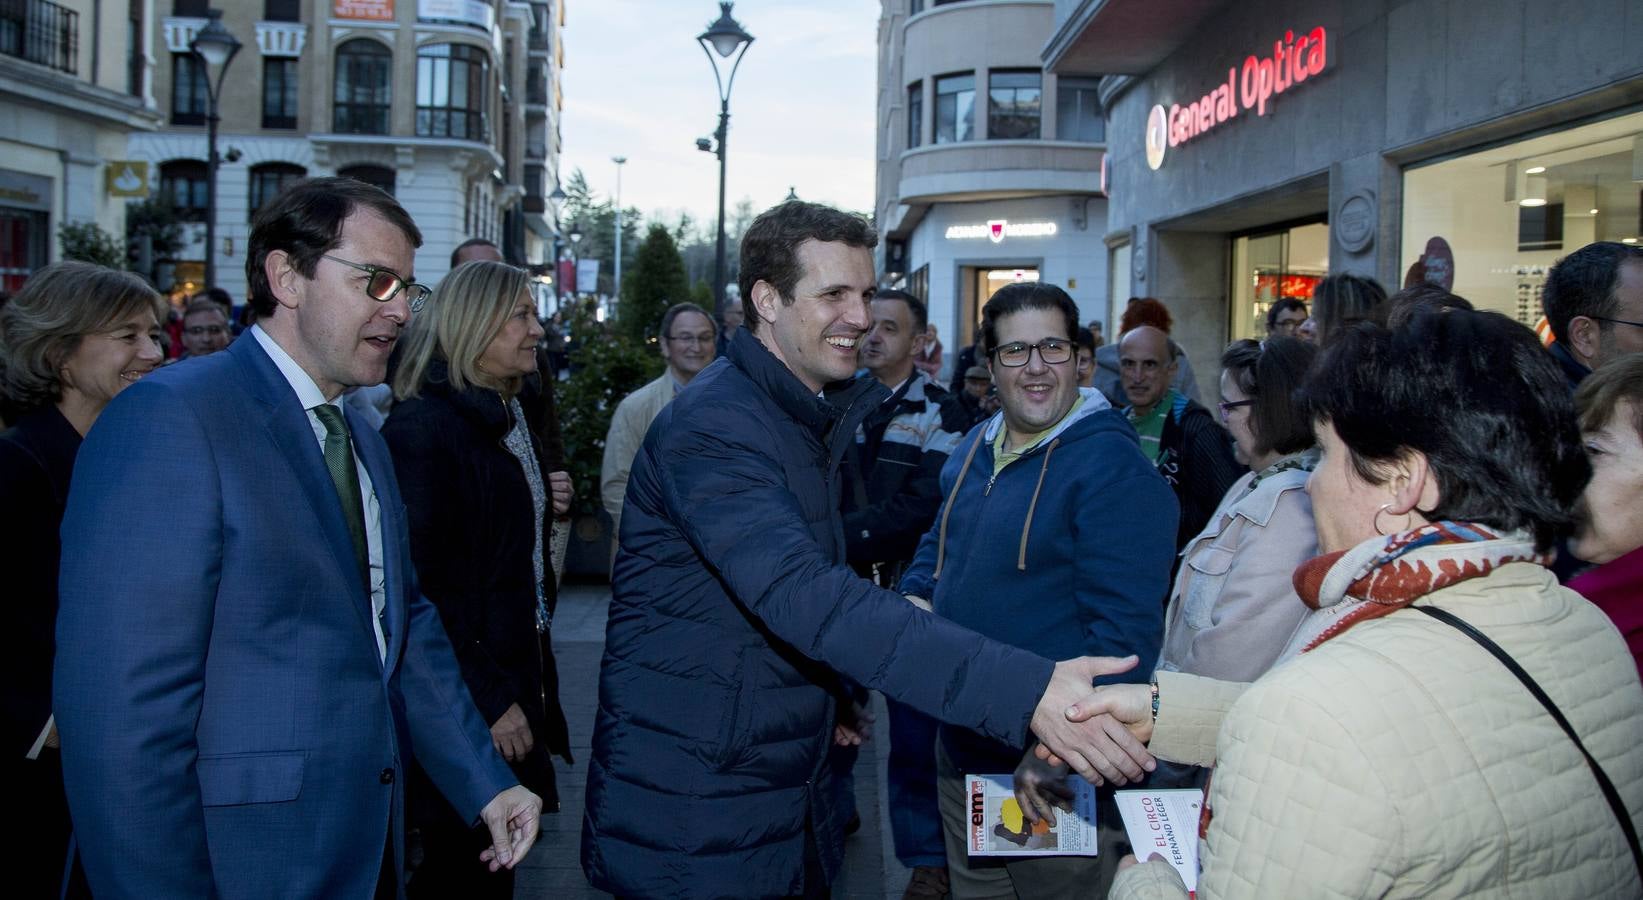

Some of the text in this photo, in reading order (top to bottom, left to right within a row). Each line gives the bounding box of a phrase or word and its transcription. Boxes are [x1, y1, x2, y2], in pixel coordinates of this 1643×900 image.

[1167, 25, 1327, 148] General Optica
[1141, 797, 1167, 847] EL CIRCO
[1163, 823, 1184, 865] FERNAND
